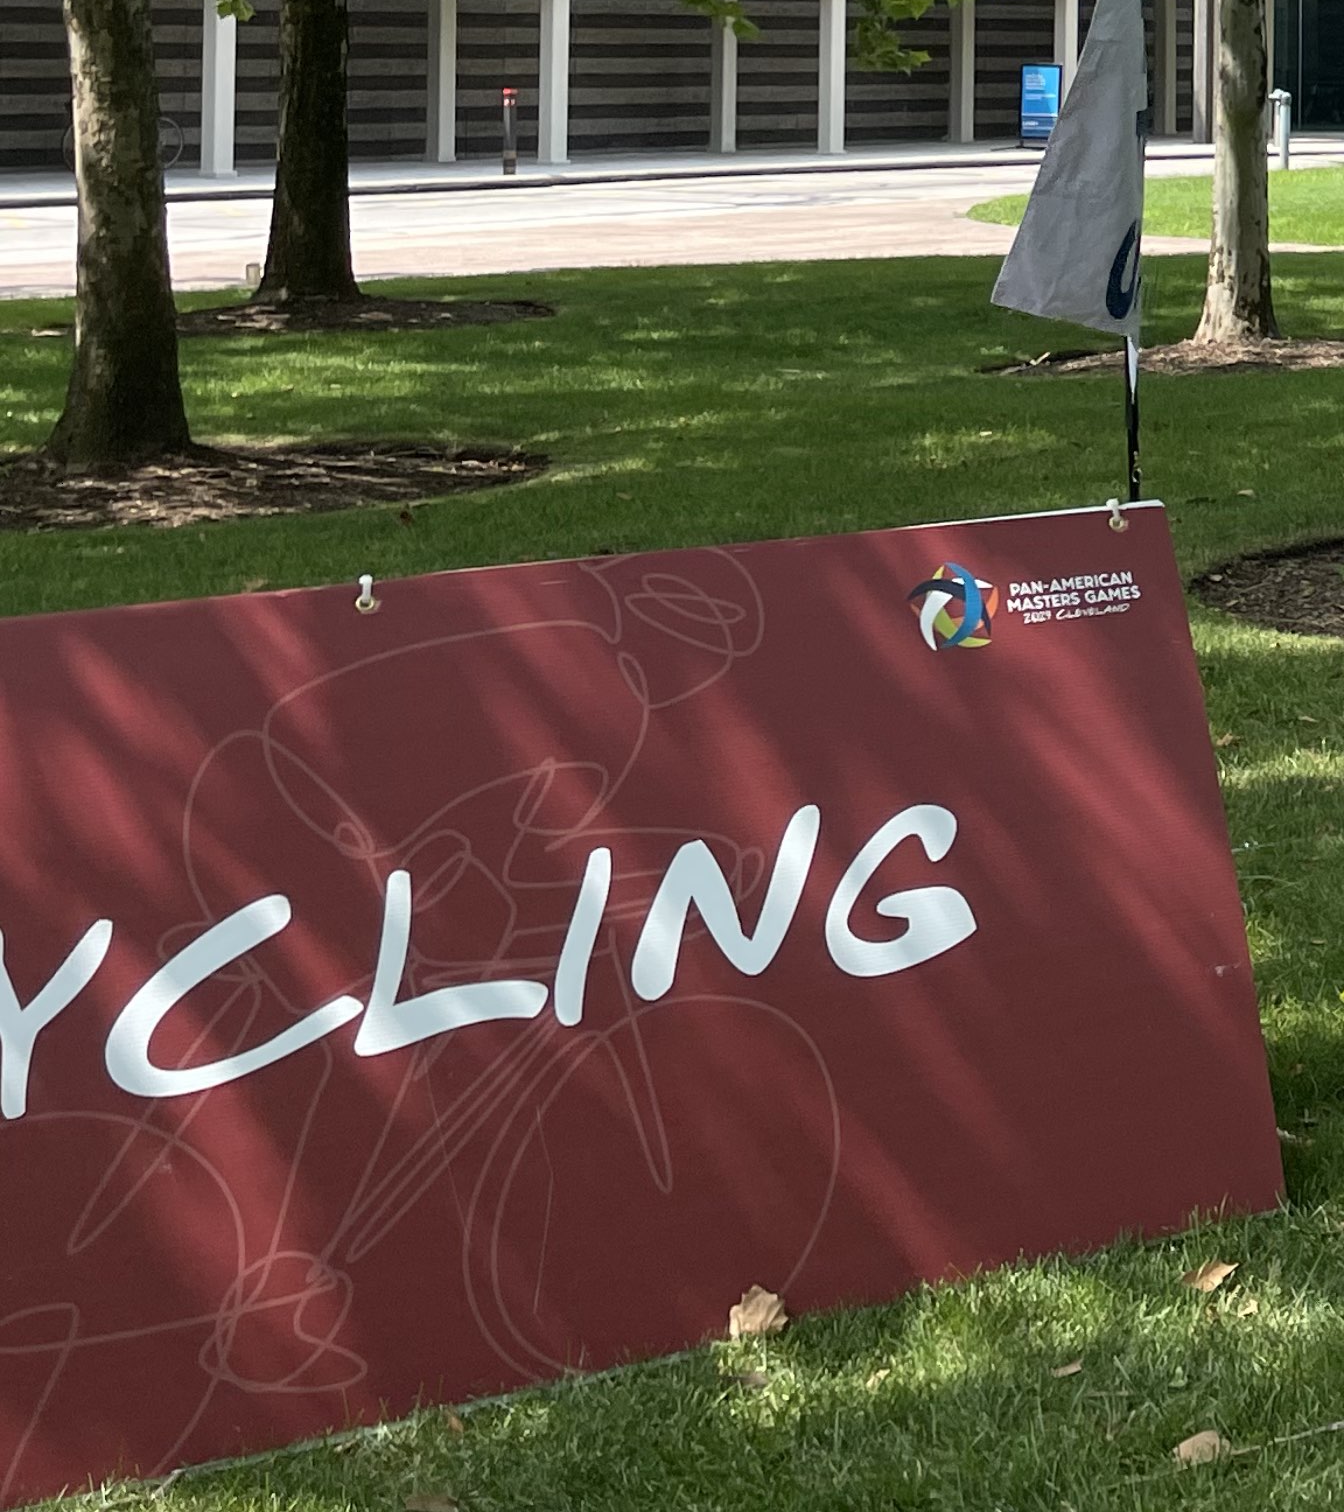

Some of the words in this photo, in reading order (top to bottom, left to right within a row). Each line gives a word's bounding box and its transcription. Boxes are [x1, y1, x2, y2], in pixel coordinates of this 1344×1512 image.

[1007, 593, 1081, 613] MASTERS
[1084, 584, 1142, 605] GAMES
[1009, 571, 1134, 597] PAN-AMERICAN
[0, 804, 978, 1121] YCLING
